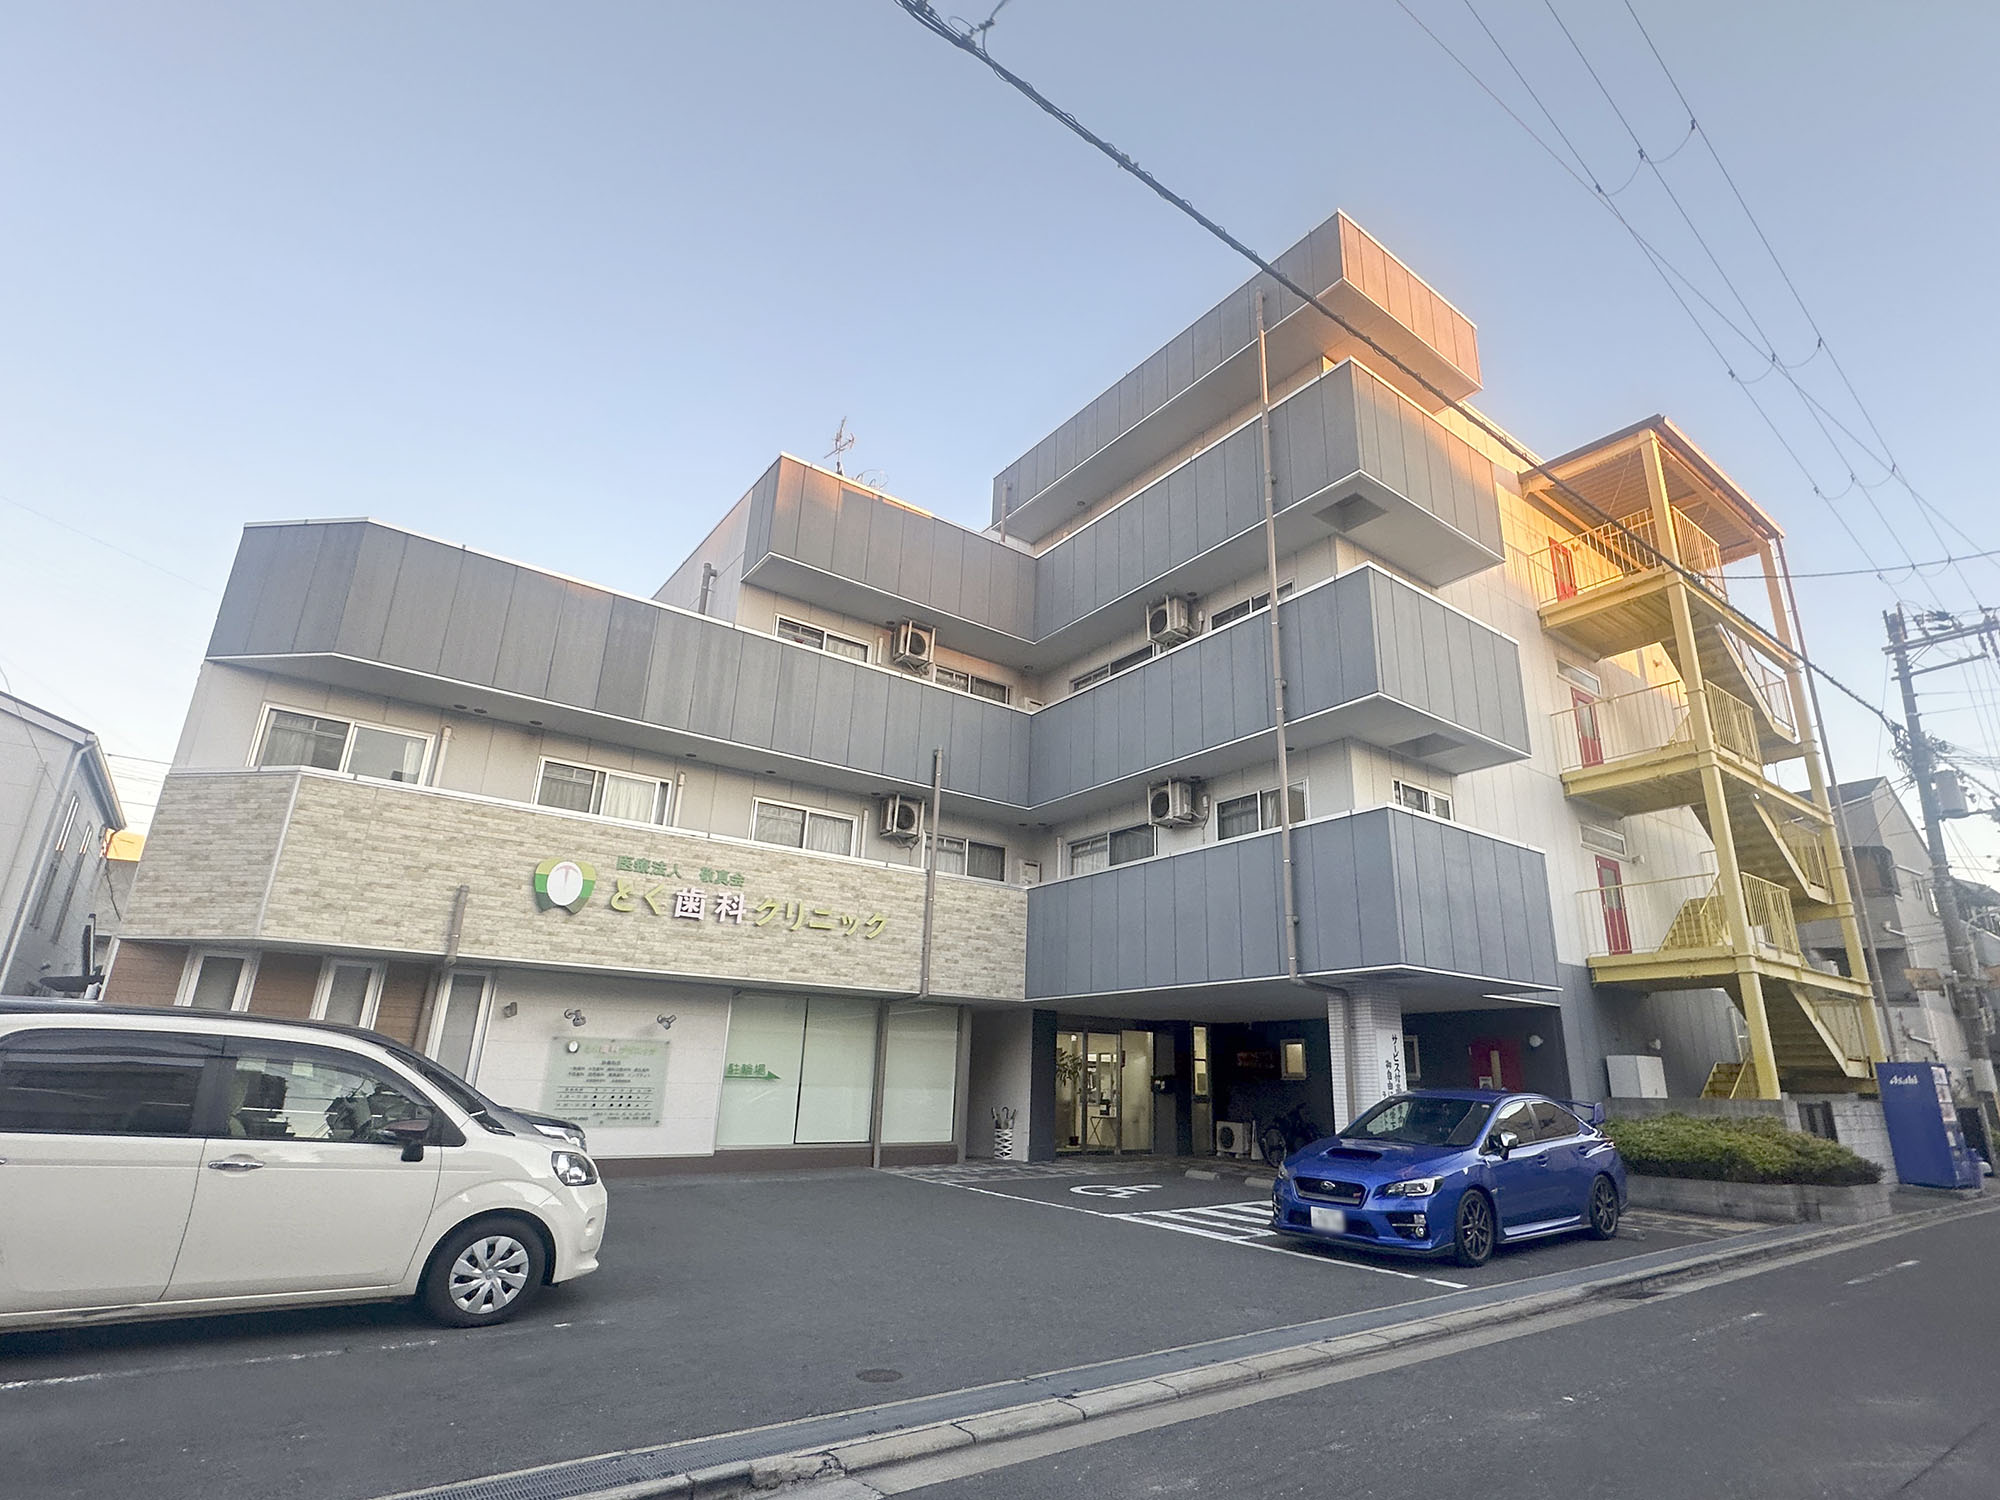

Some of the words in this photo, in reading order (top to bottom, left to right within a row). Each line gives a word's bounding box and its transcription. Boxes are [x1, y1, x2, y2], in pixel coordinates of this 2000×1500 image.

[616, 855, 682, 879] 医療法人
[610, 878, 888, 939] とく歯科クリニック
[1889, 1075, 1918, 1085] Asahi
